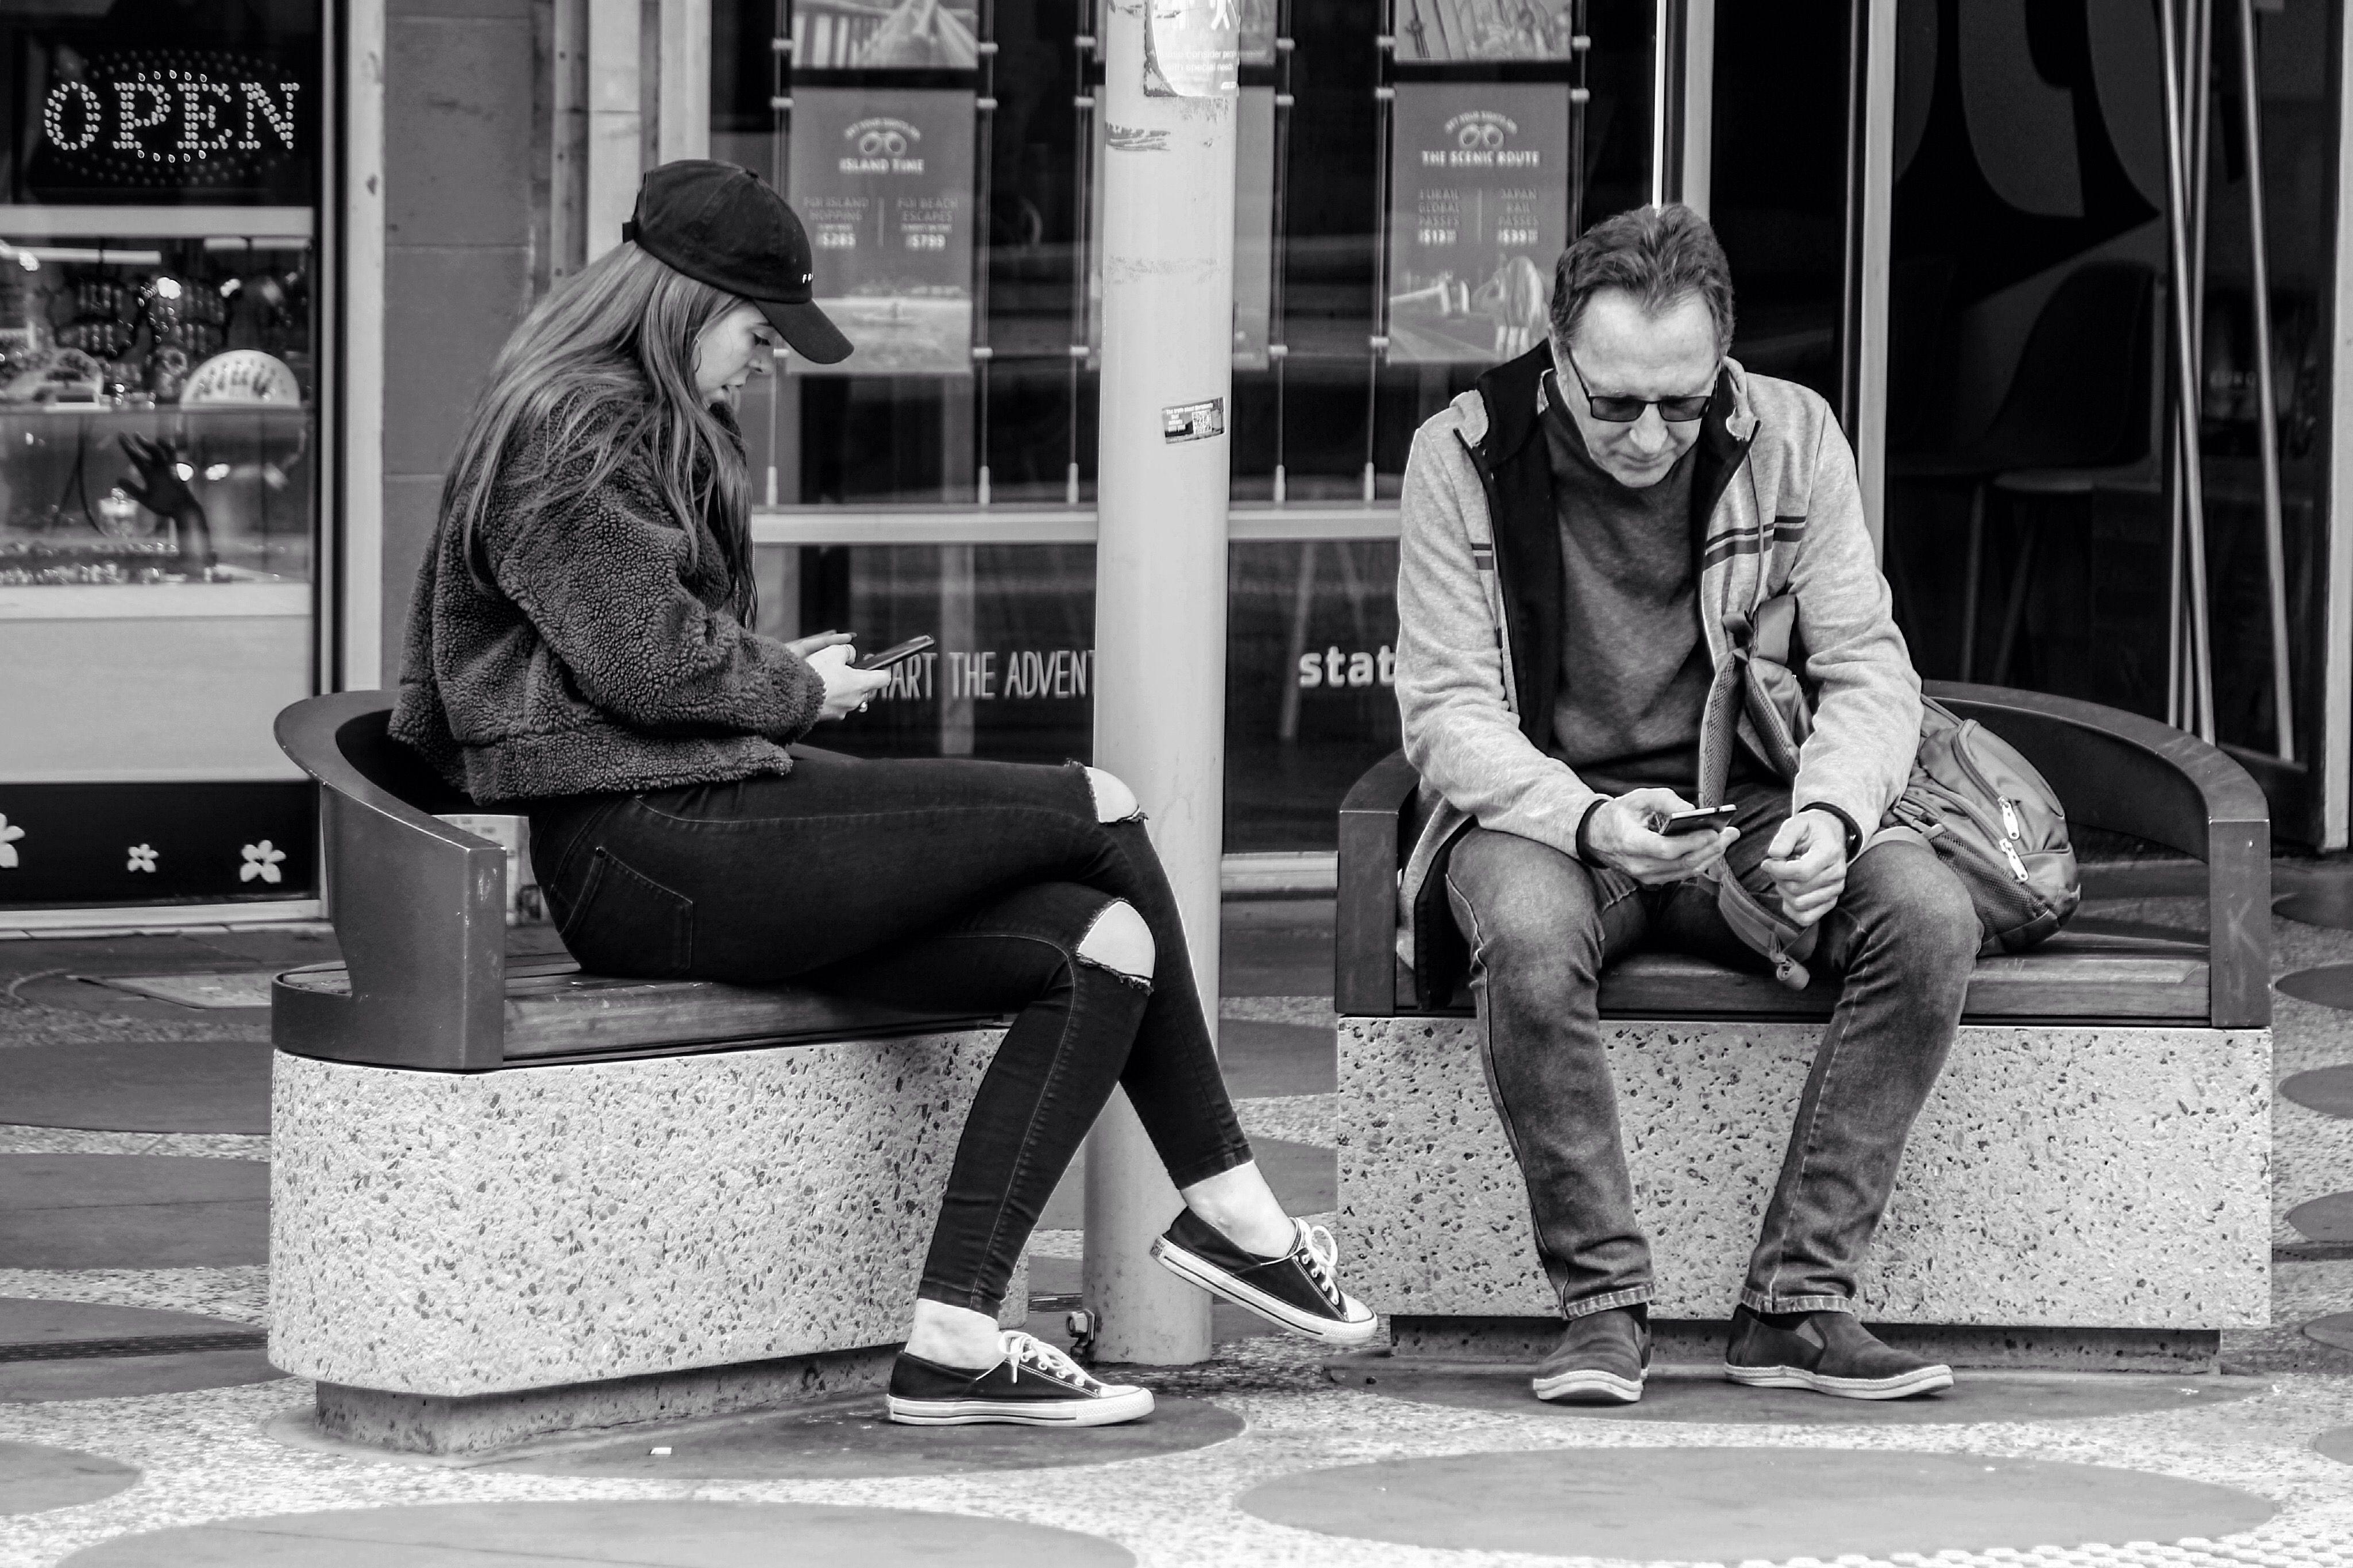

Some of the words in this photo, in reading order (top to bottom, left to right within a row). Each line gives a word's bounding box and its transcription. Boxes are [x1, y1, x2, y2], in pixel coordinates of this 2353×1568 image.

[45, 81, 300, 150] OPEN
[839, 157, 889, 173] ISLAND
[892, 157, 924, 174] TIME
[1421, 150, 1446, 167] THE
[1449, 150, 1493, 167] SCENIC
[1497, 150, 1540, 167] ROUTE
[1500, 188, 1538, 200] JAPAN
[1498, 215, 1539, 227] PASSES
[949, 651, 996, 699] THE
[1299, 645, 1396, 688] stat
